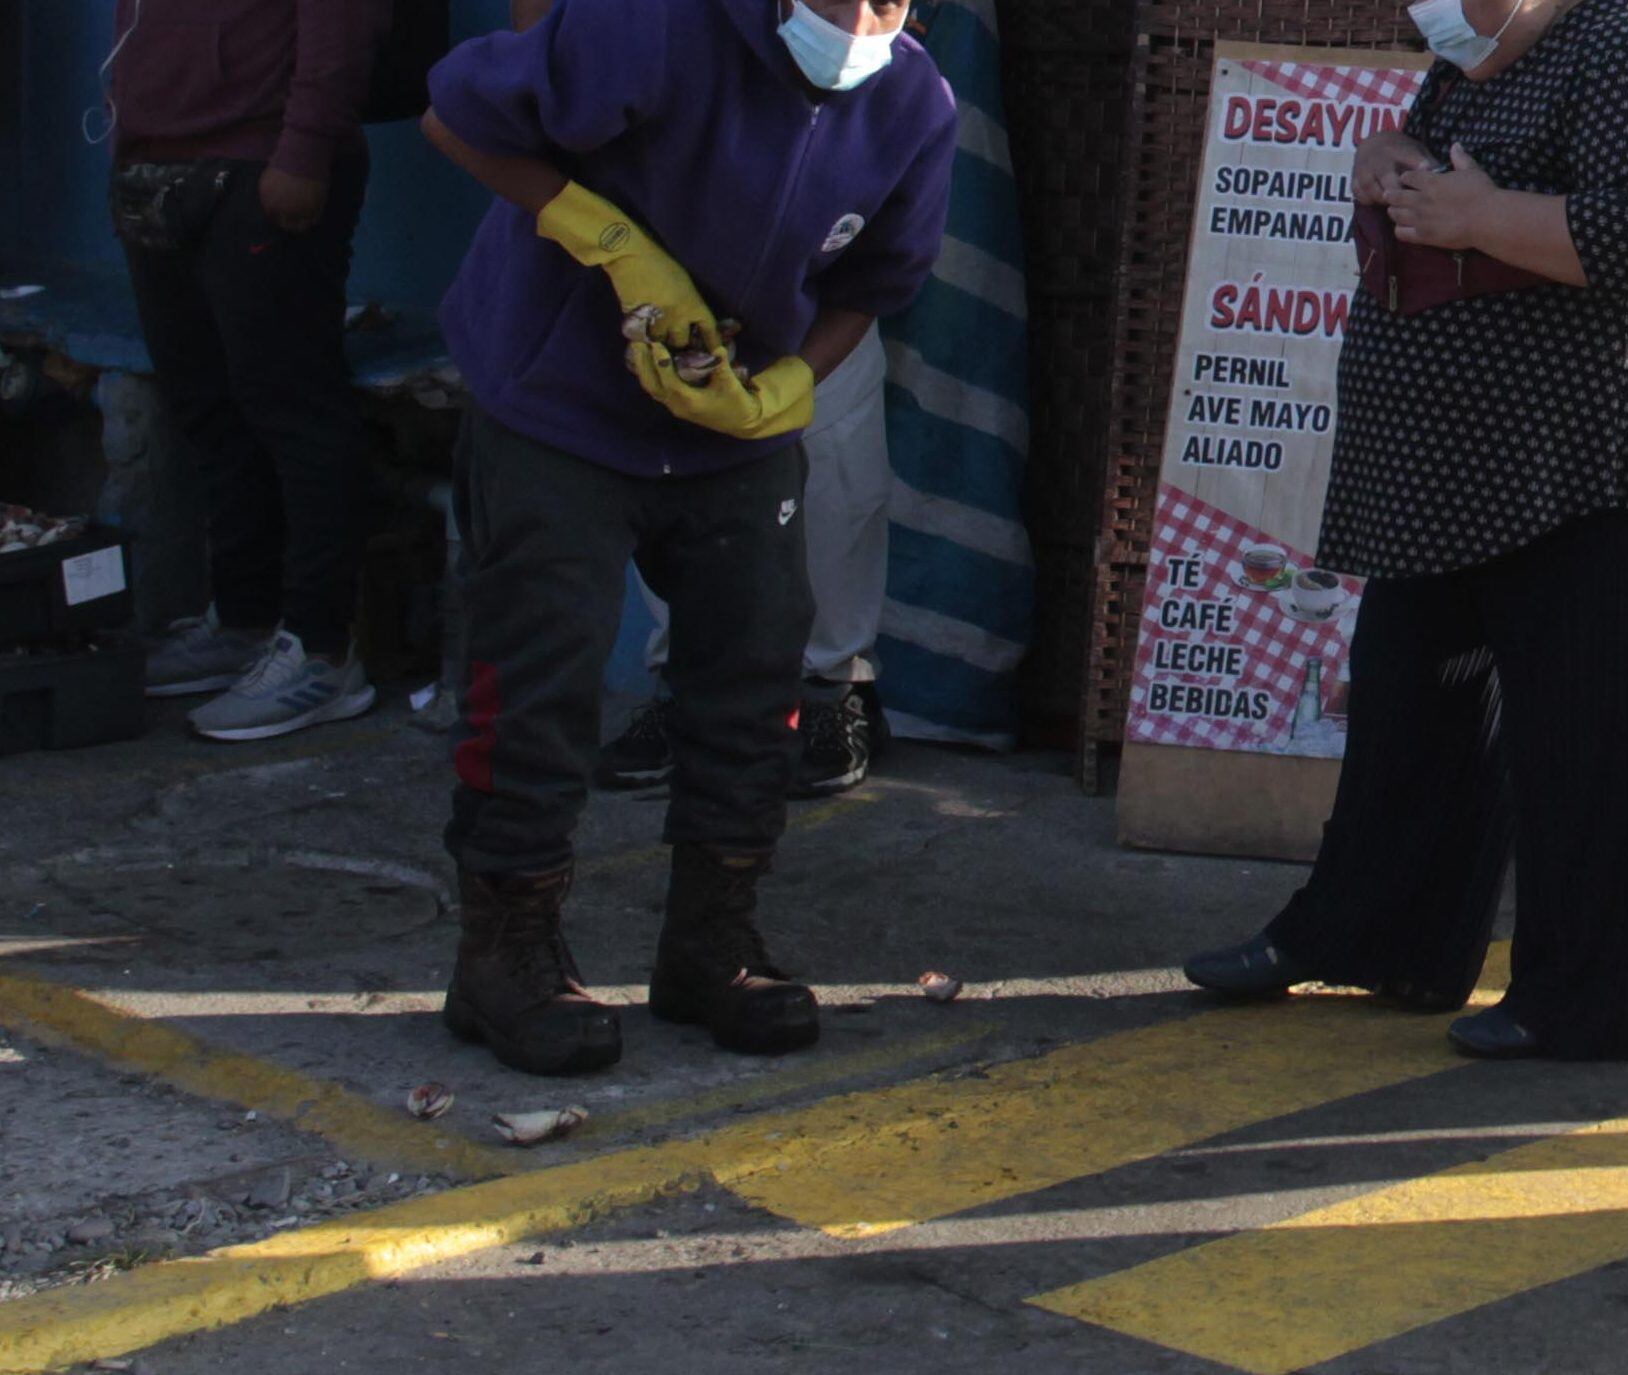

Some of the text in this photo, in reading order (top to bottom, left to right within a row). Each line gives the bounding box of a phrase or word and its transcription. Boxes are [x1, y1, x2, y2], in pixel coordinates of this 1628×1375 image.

[1223, 95, 1408, 148] DESAYUN
[1215, 167, 1352, 202] SOPAIPILL
[1210, 207, 1355, 243] EMPANADA
[1210, 273, 1351, 337] SÁNDW
[1194, 354, 1290, 388] PERNIL
[1187, 395, 1331, 433] AVE MAYO
[1182, 436, 1283, 470] ALIADO
[1168, 553, 1202, 588] TÉ
[1161, 597, 1234, 633] CAFÉ
[1155, 641, 1243, 676] LECHE
[1148, 683, 1269, 720] BEBIDAS
